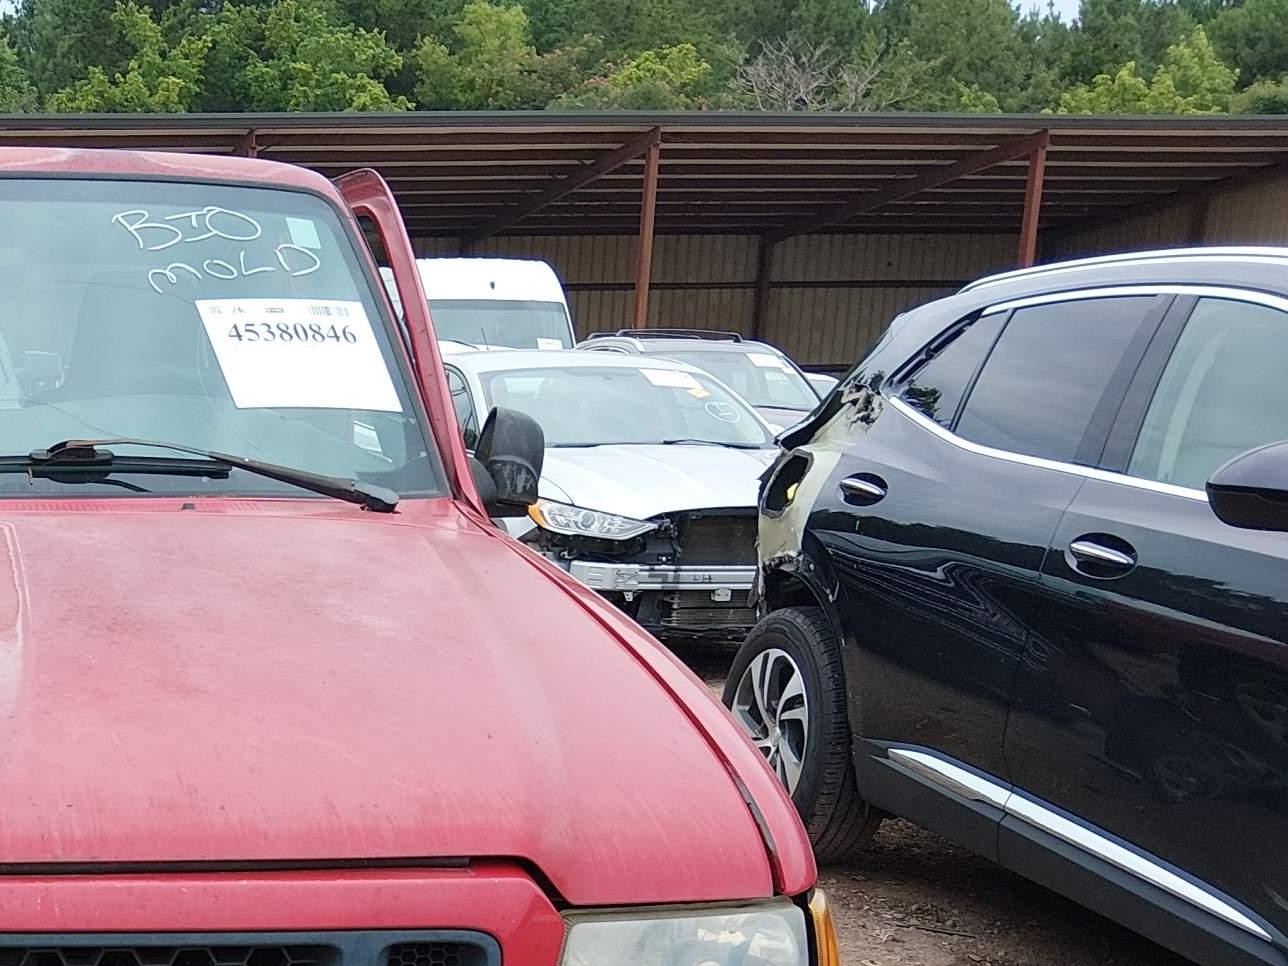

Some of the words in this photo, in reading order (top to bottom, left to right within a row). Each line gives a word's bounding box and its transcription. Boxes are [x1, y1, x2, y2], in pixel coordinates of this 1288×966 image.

[111, 205, 262, 251] BIO
[147, 243, 321, 294] MOLD
[227, 322, 358, 344] 45380846
